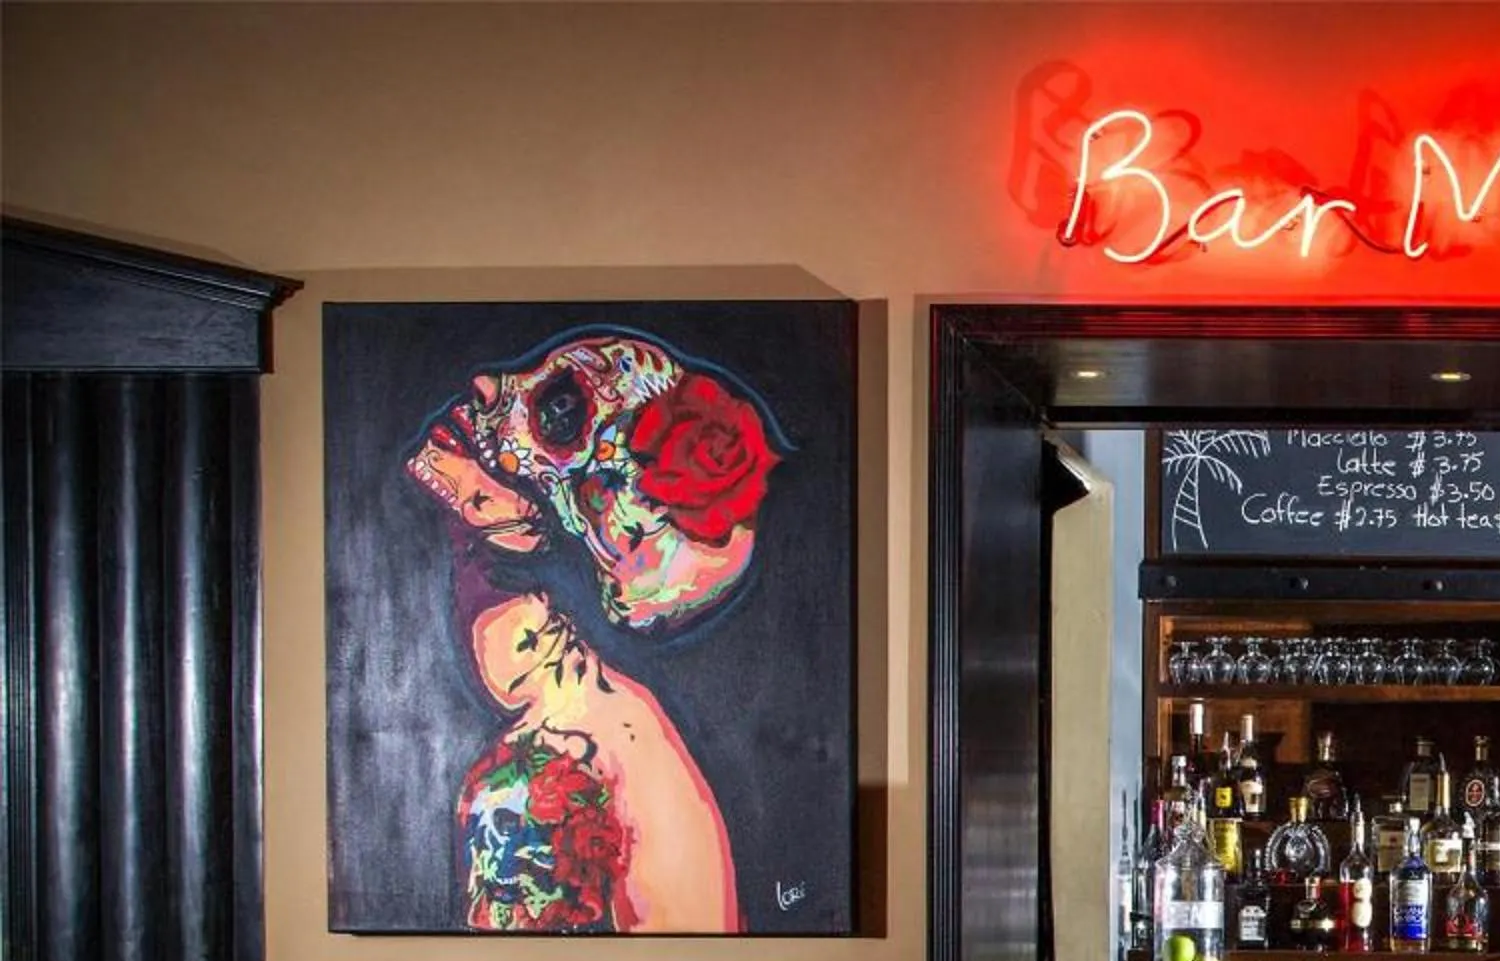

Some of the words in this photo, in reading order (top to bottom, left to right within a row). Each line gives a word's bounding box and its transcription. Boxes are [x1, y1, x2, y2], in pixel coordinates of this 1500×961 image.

[1062, 109, 1357, 265] Bar
[1317, 475, 1417, 501] Espresso
[1429, 472, 1496, 507] $3.50
[1241, 492, 1324, 524] Coffee
[1412, 501, 1450, 528] Hot
